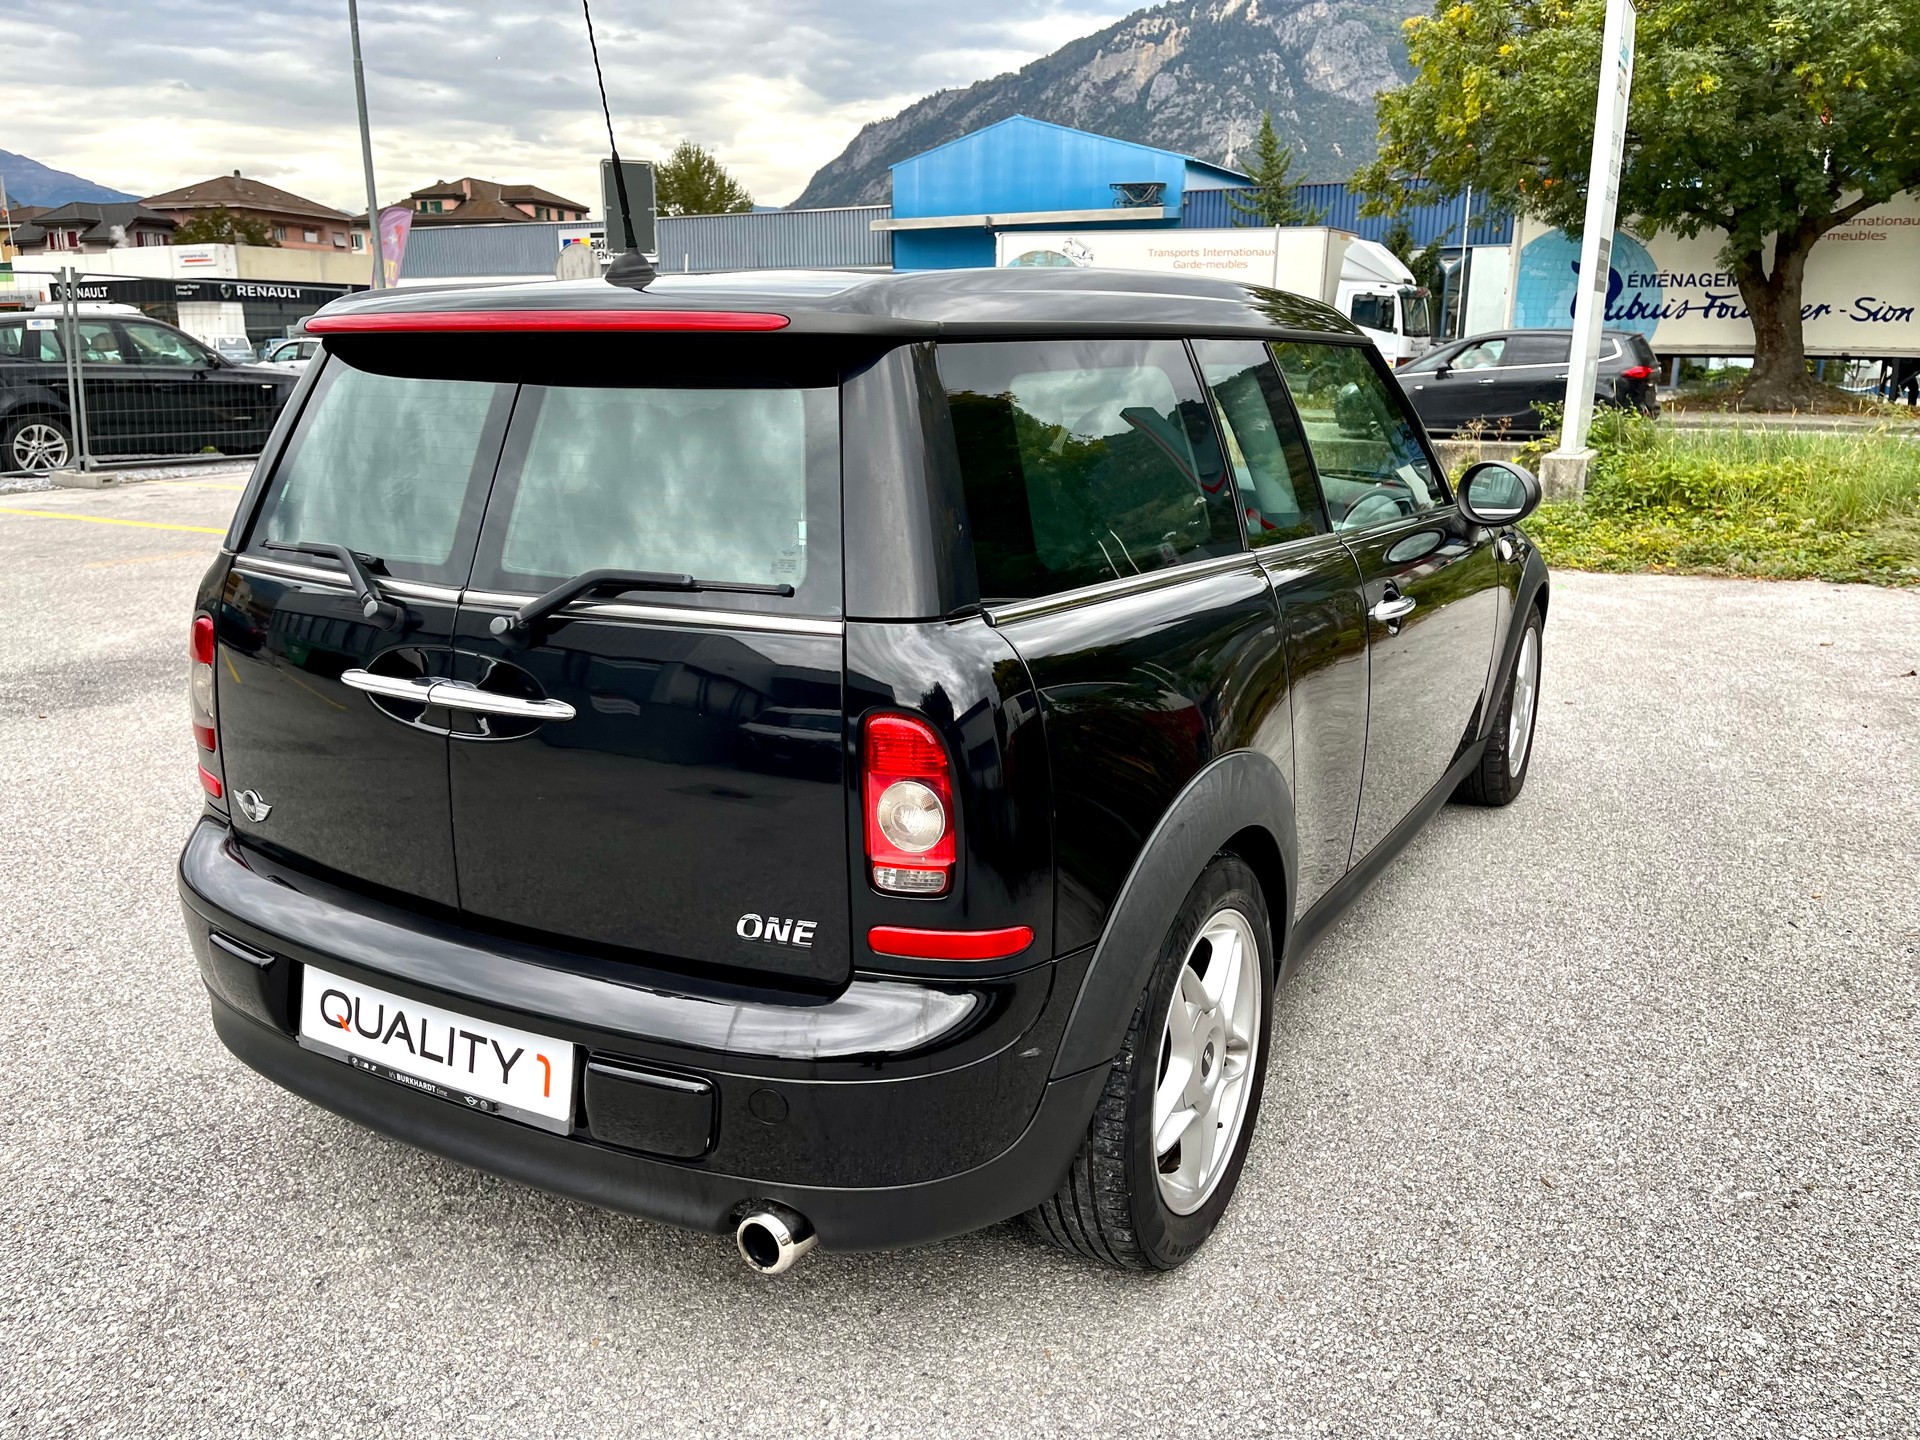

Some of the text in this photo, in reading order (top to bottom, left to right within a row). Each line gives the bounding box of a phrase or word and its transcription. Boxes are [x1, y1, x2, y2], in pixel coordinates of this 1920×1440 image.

[1840, 215, 1920, 227] ernationau
[1147, 247, 1277, 259] Transports Internationaux
[1172, 259, 1249, 270] Garde-meubles
[1626, 269, 1741, 289] ÉMÉNAGEM
[65, 286, 108, 299] RNAULT
[1849, 296, 1915, 323] Sion
[736, 912, 818, 948] ONE
[396, 1073, 436, 1093] BURKHARDT
[436, 1087, 448, 1097] time
